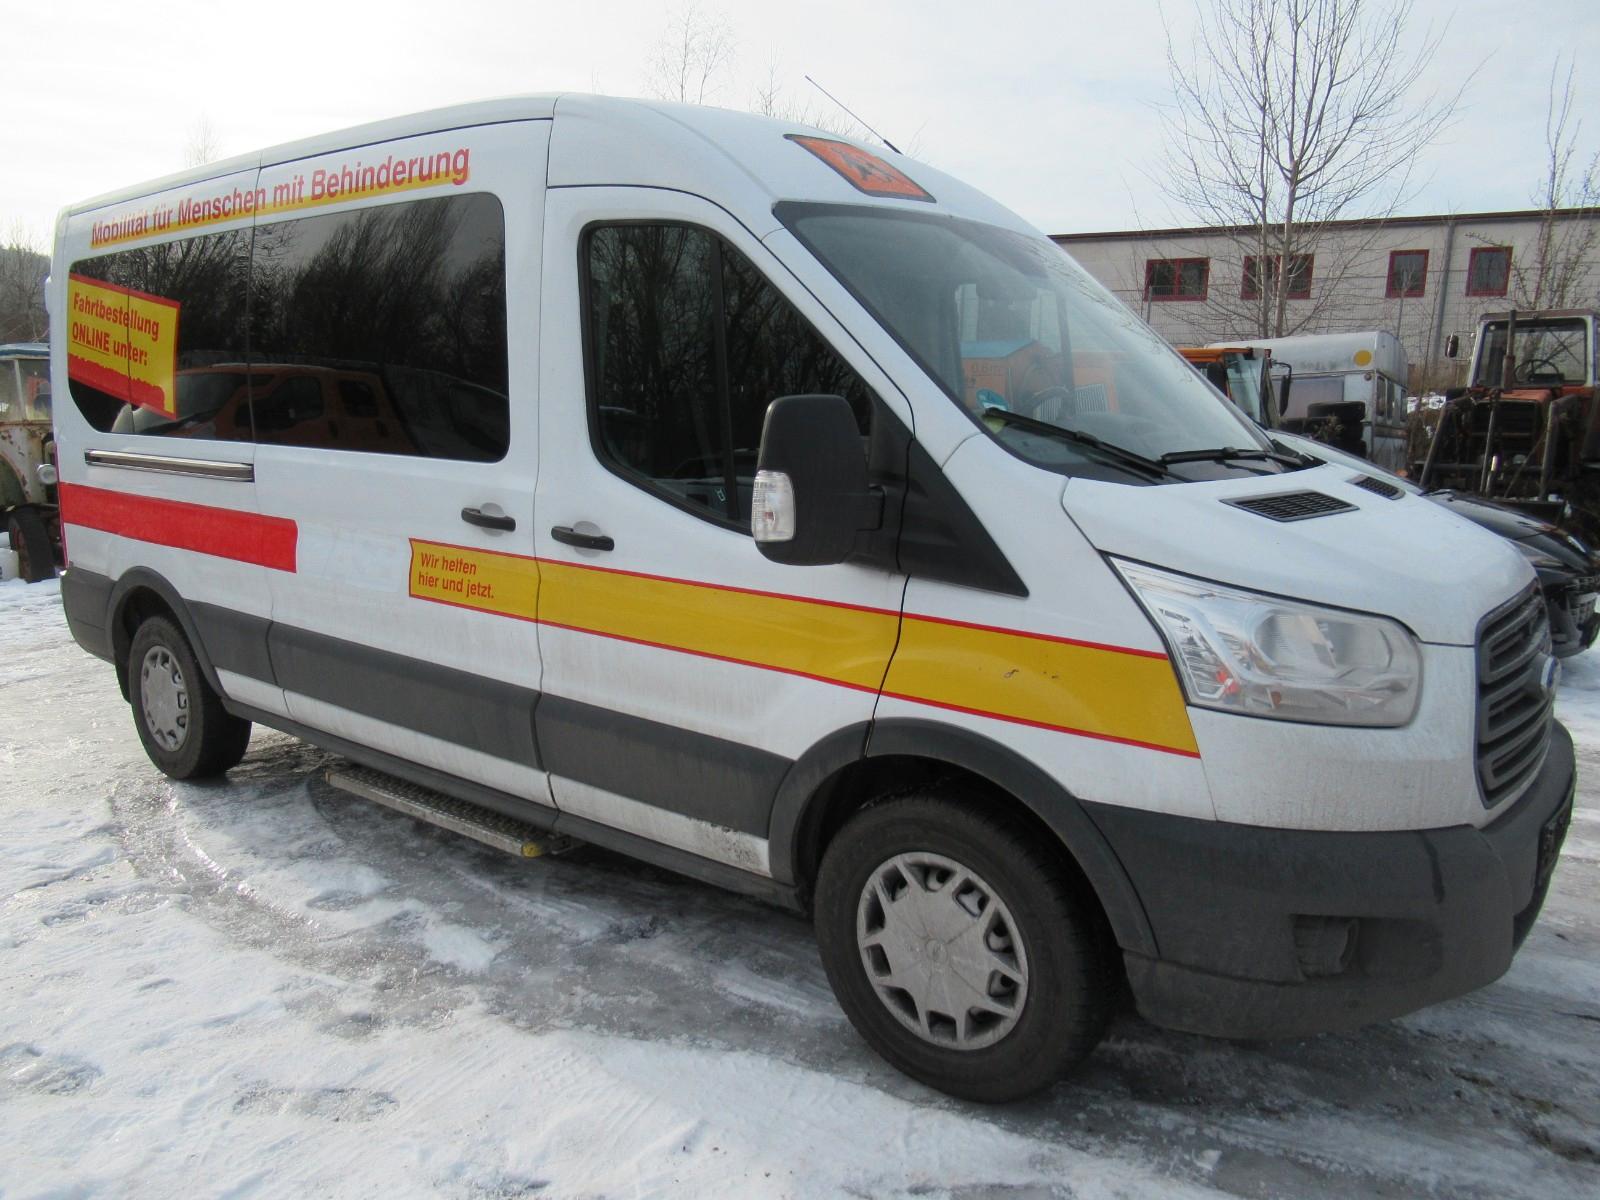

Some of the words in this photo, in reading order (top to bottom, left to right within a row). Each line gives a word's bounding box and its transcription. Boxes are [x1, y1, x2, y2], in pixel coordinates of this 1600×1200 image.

[91, 209, 149, 245] Mobilität
[152, 202, 174, 231] für
[177, 187, 267, 226] Menschen
[273, 174, 305, 208] mit
[311, 148, 470, 201] Behinderung
[73, 292, 160, 342] Fahrtbestellung
[72, 321, 111, 353] ONLINE
[113, 340, 148, 366] unter:
[418, 570, 440, 588] hier
[442, 577, 464, 593] und
[466, 578, 495, 599] jetzt.
[420, 552, 440, 569] Wir
[441, 555, 477, 576] helfen
